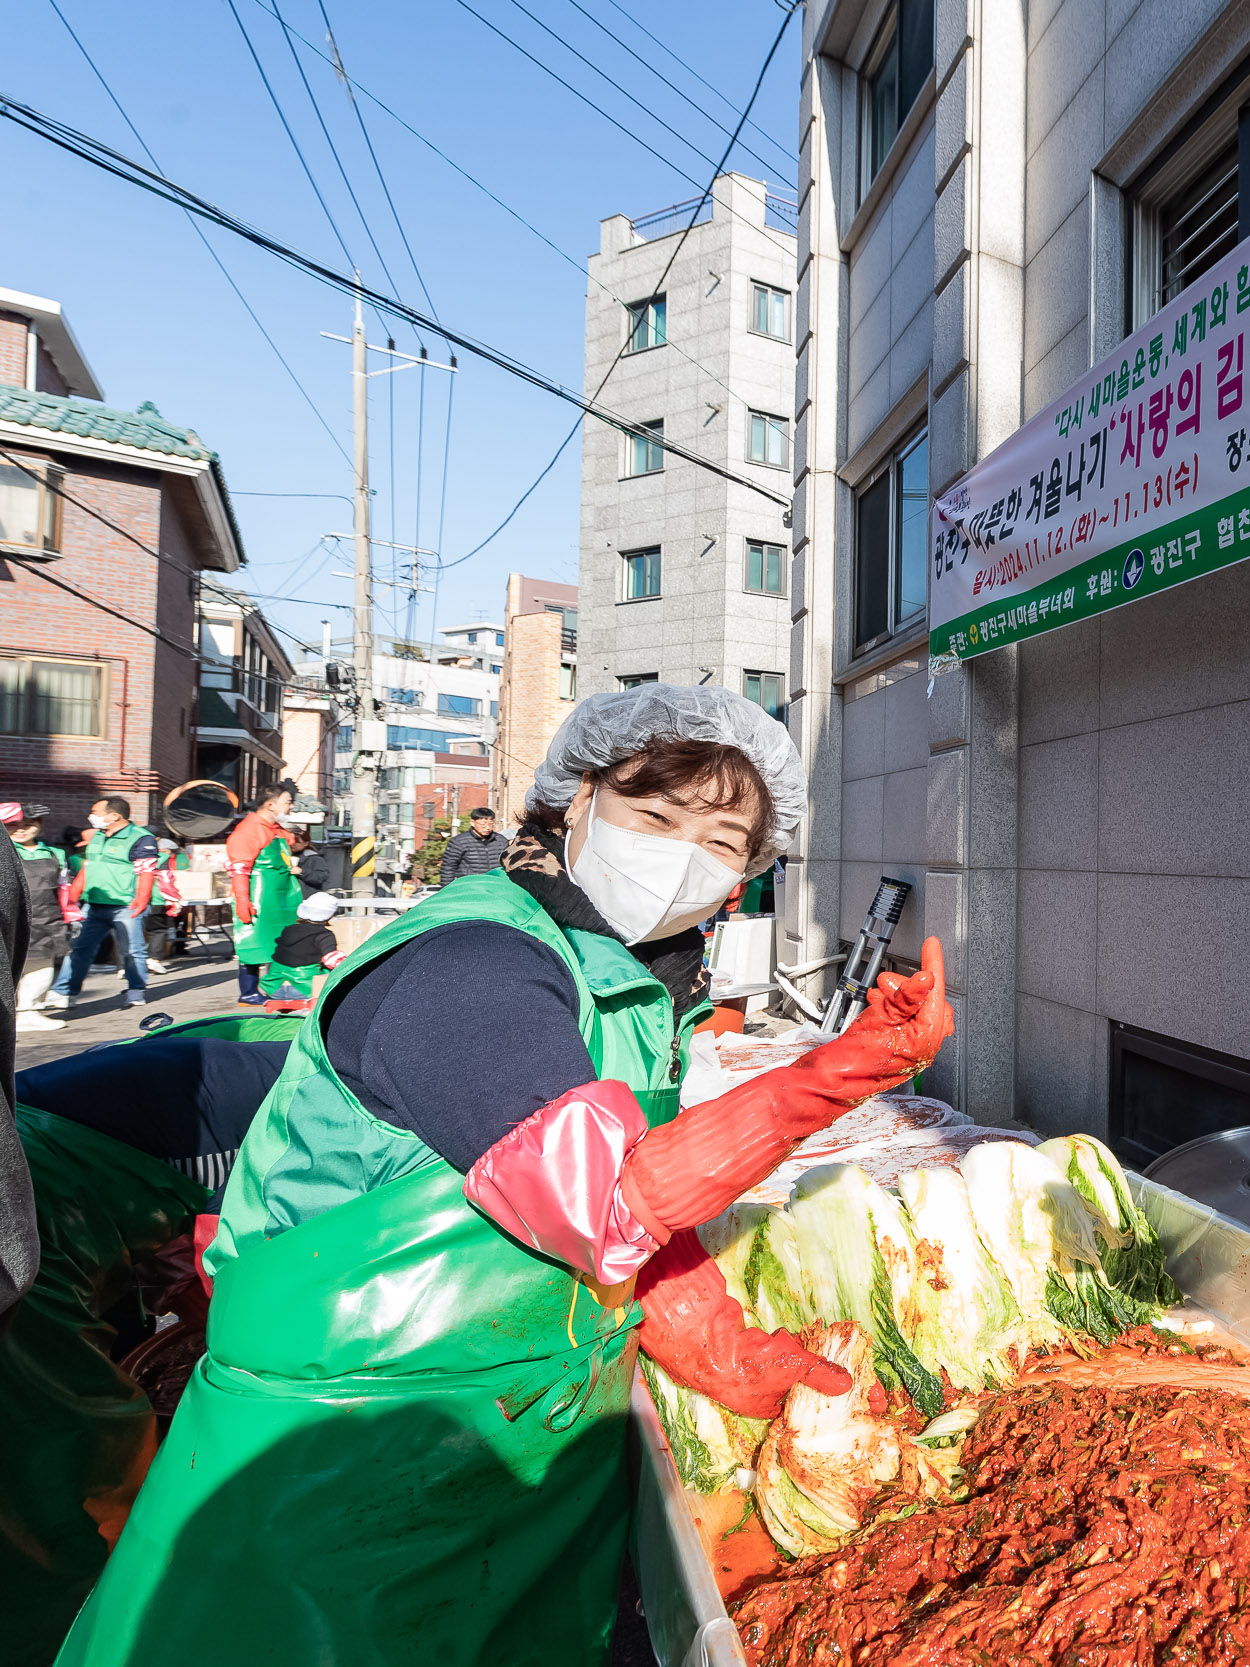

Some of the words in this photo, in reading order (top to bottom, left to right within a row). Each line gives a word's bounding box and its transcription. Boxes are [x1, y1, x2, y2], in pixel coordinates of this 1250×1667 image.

[1025, 426, 1108, 525] 겨울나기
[979, 586, 1075, 642] 광진구새마을부녀회
[1085, 568, 1118, 601] 후원:
[1150, 529, 1202, 576] 광진구
